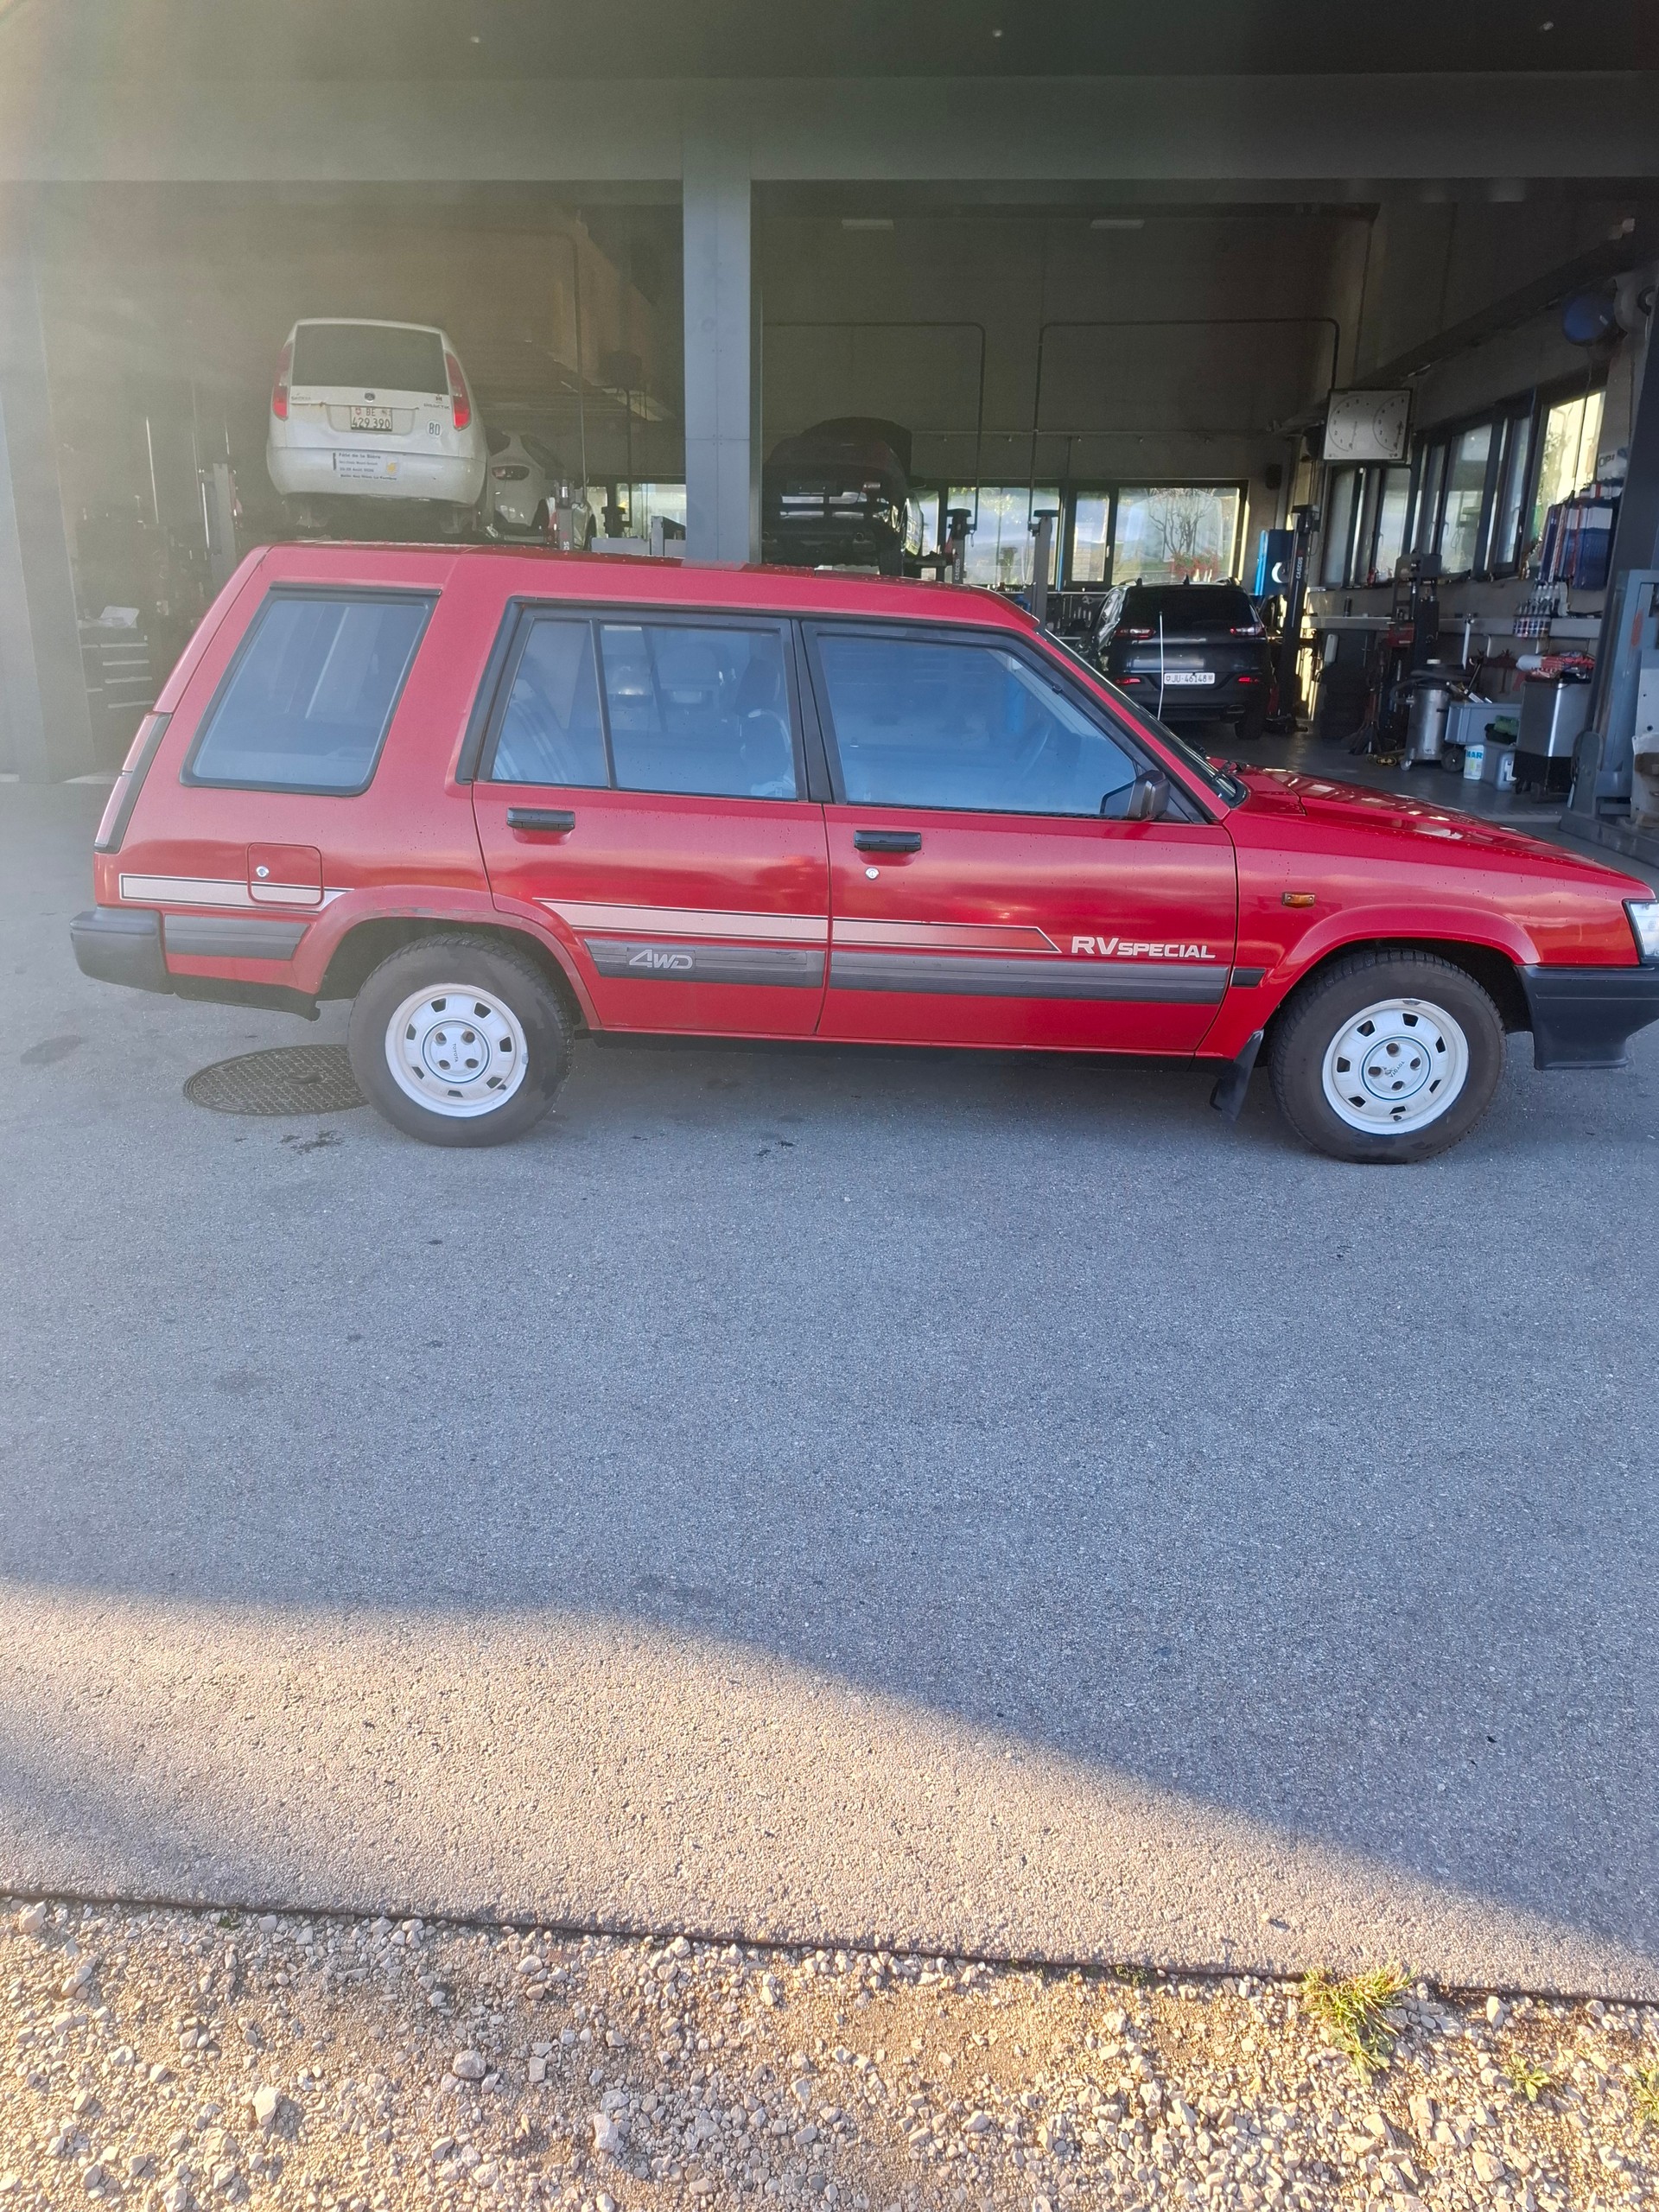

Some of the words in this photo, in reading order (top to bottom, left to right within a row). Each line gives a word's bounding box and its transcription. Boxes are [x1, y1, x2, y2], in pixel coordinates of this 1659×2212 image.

[365, 408, 376, 416] BE
[352, 416, 371, 429] 429
[372, 418, 391, 429] 390
[429, 422, 441, 435] 80
[628, 949, 693, 969] 4WD
[1390, 1060, 1405, 1077] TOYOTA
